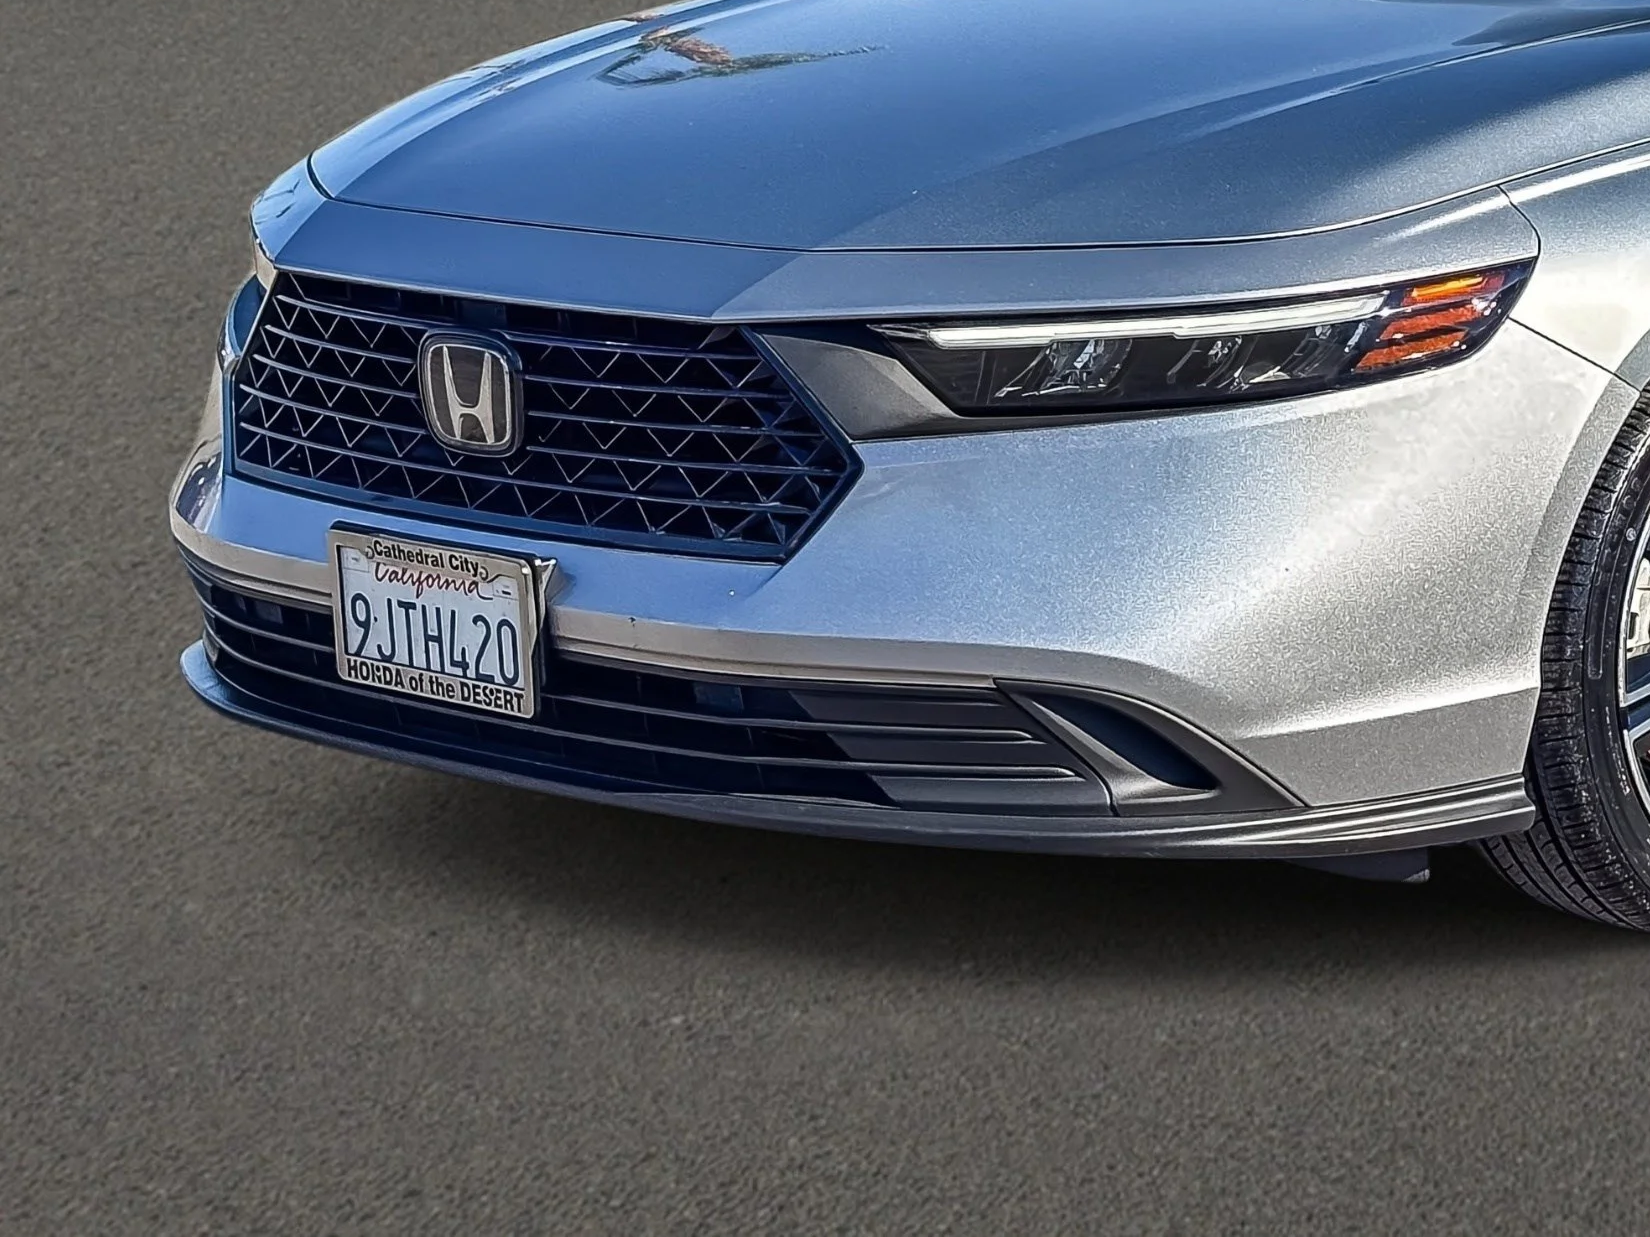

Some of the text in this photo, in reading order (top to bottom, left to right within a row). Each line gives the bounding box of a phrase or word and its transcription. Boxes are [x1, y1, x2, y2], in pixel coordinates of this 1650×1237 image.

[372, 539, 480, 580] Cathedral City
[374, 562, 494, 601] California
[350, 592, 520, 687] 9JTH420
[347, 657, 525, 713] HONDA of the DESERT
